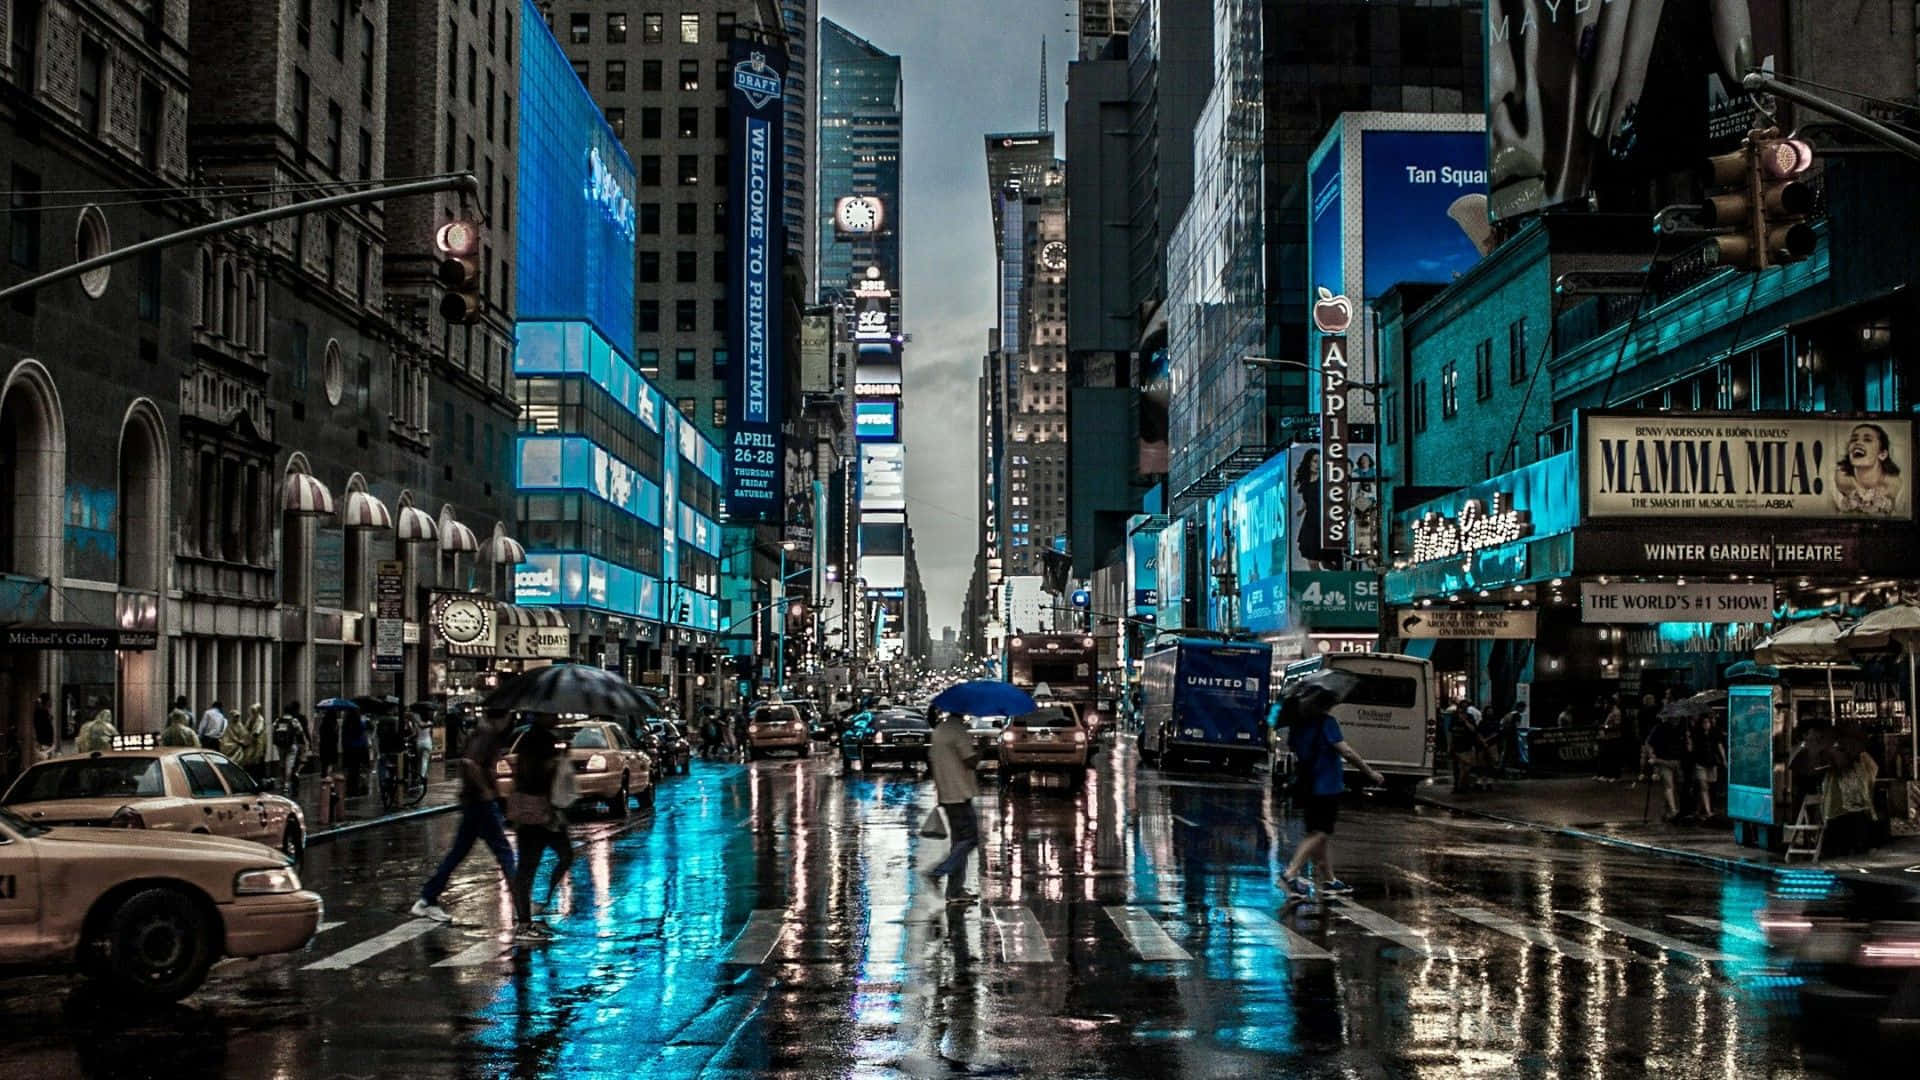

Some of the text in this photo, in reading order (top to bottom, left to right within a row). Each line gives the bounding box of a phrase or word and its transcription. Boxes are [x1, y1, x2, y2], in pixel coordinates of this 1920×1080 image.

[737, 73, 778, 92] DRAFT
[1406, 166, 1436, 183] Tan
[750, 127, 765, 414] WELCOME TO PRIMETIME
[734, 431, 775, 447] APRIL
[1635, 426, 1668, 437] BENNY
[1323, 341, 1348, 541] Applebee's
[735, 448, 774, 465] 26-28
[734, 467, 775, 478] THURSDAY
[1600, 439, 1823, 495] MAMMA MIA!
[741, 478, 768, 488] FRIDAY
[735, 489, 774, 499] SATURDAY
[1632, 498, 1648, 509] THE
[1650, 498, 1681, 509] SMASH
[1682, 498, 1697, 509] HIT
[1699, 498, 1735, 509] MUSICAL
[1765, 499, 1794, 509] ABBA
[1644, 543, 1844, 560] WINTER GARDEN THEATRE
[1302, 581, 1322, 605] 4
[1590, 594, 1768, 611] THE WORLD'S #1 SHOW!
[8, 632, 109, 648] Michael's Gallery
[1187, 675, 1243, 688] UNITED
